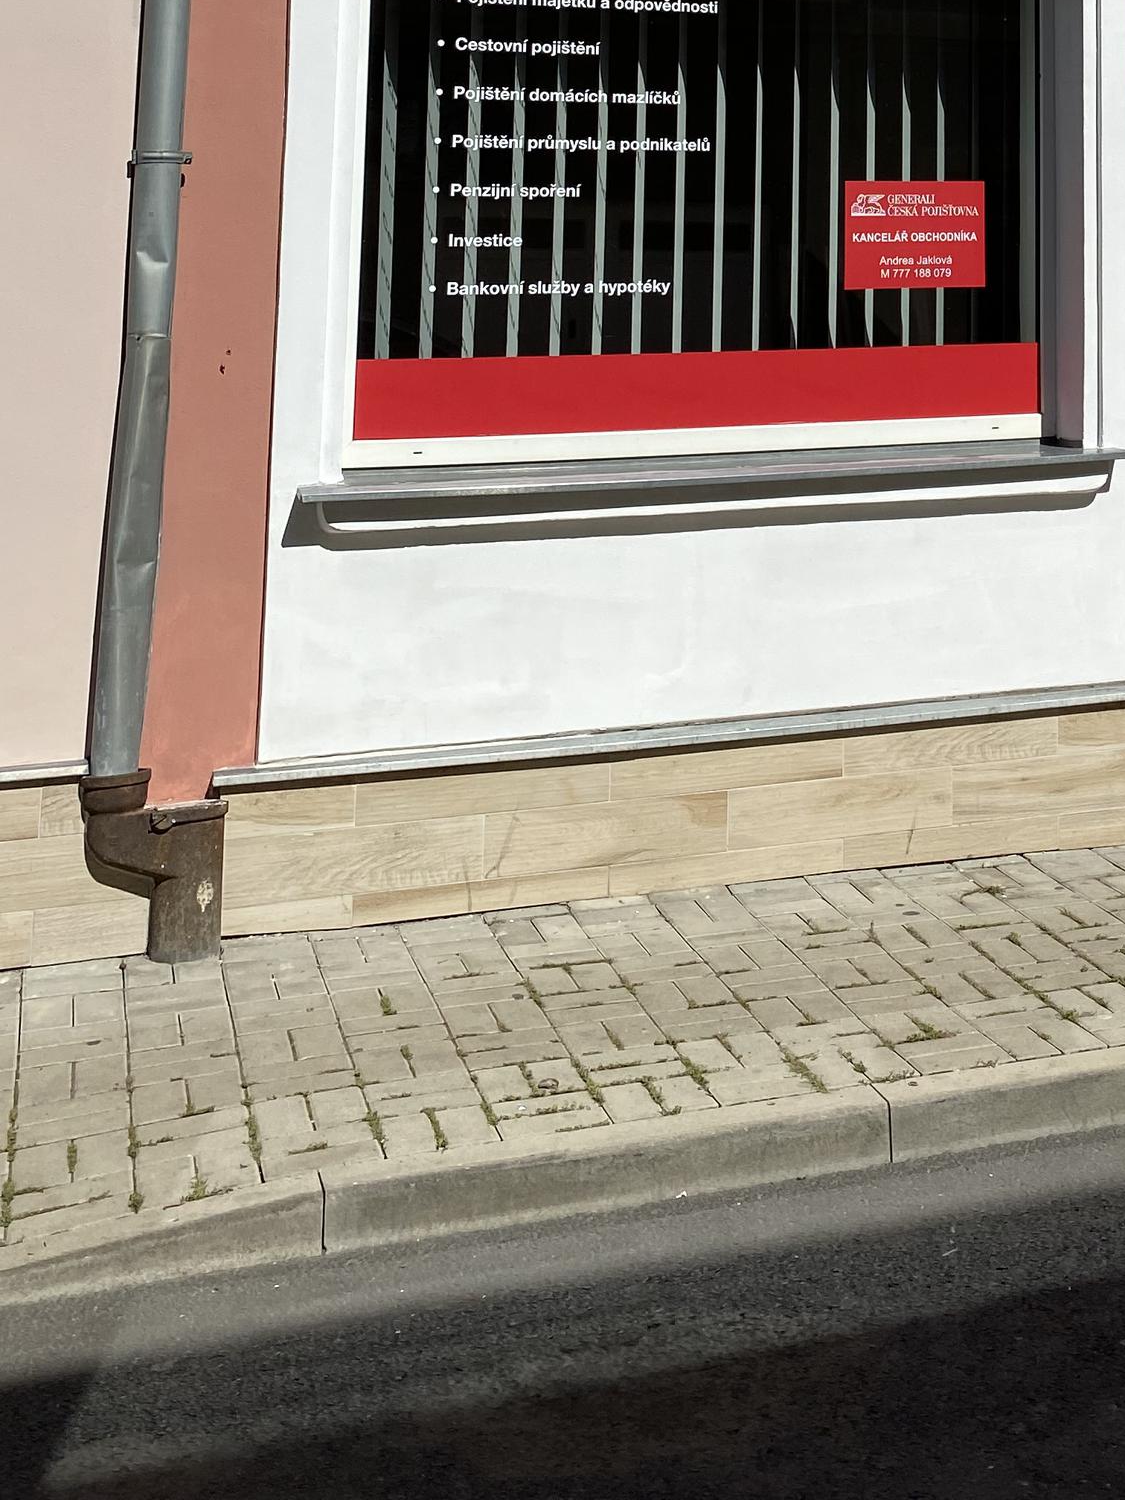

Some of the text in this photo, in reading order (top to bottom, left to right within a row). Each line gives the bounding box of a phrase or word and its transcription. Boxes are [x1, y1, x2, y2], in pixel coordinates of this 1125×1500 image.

[455, 37, 600, 56] Cestovní pojištění
[454, 86, 681, 105] Pojištění domácích mazlíčků
[452, 135, 710, 154] Pojištění průmyslu a podnikatelů
[450, 183, 582, 200] Penzijní spoření
[887, 194, 935, 204] GENERALI
[888, 204, 979, 216] ČESKÁ POJIŠŤOVNA
[448, 233, 522, 248] Investice
[852, 230, 978, 242] KANCELÁŘ OBCHODNÍKA
[879, 256, 914, 265] Andrea
[881, 268, 952, 278] M 777 188 079
[447, 279, 670, 296] Bankovní služby a hypotéky
